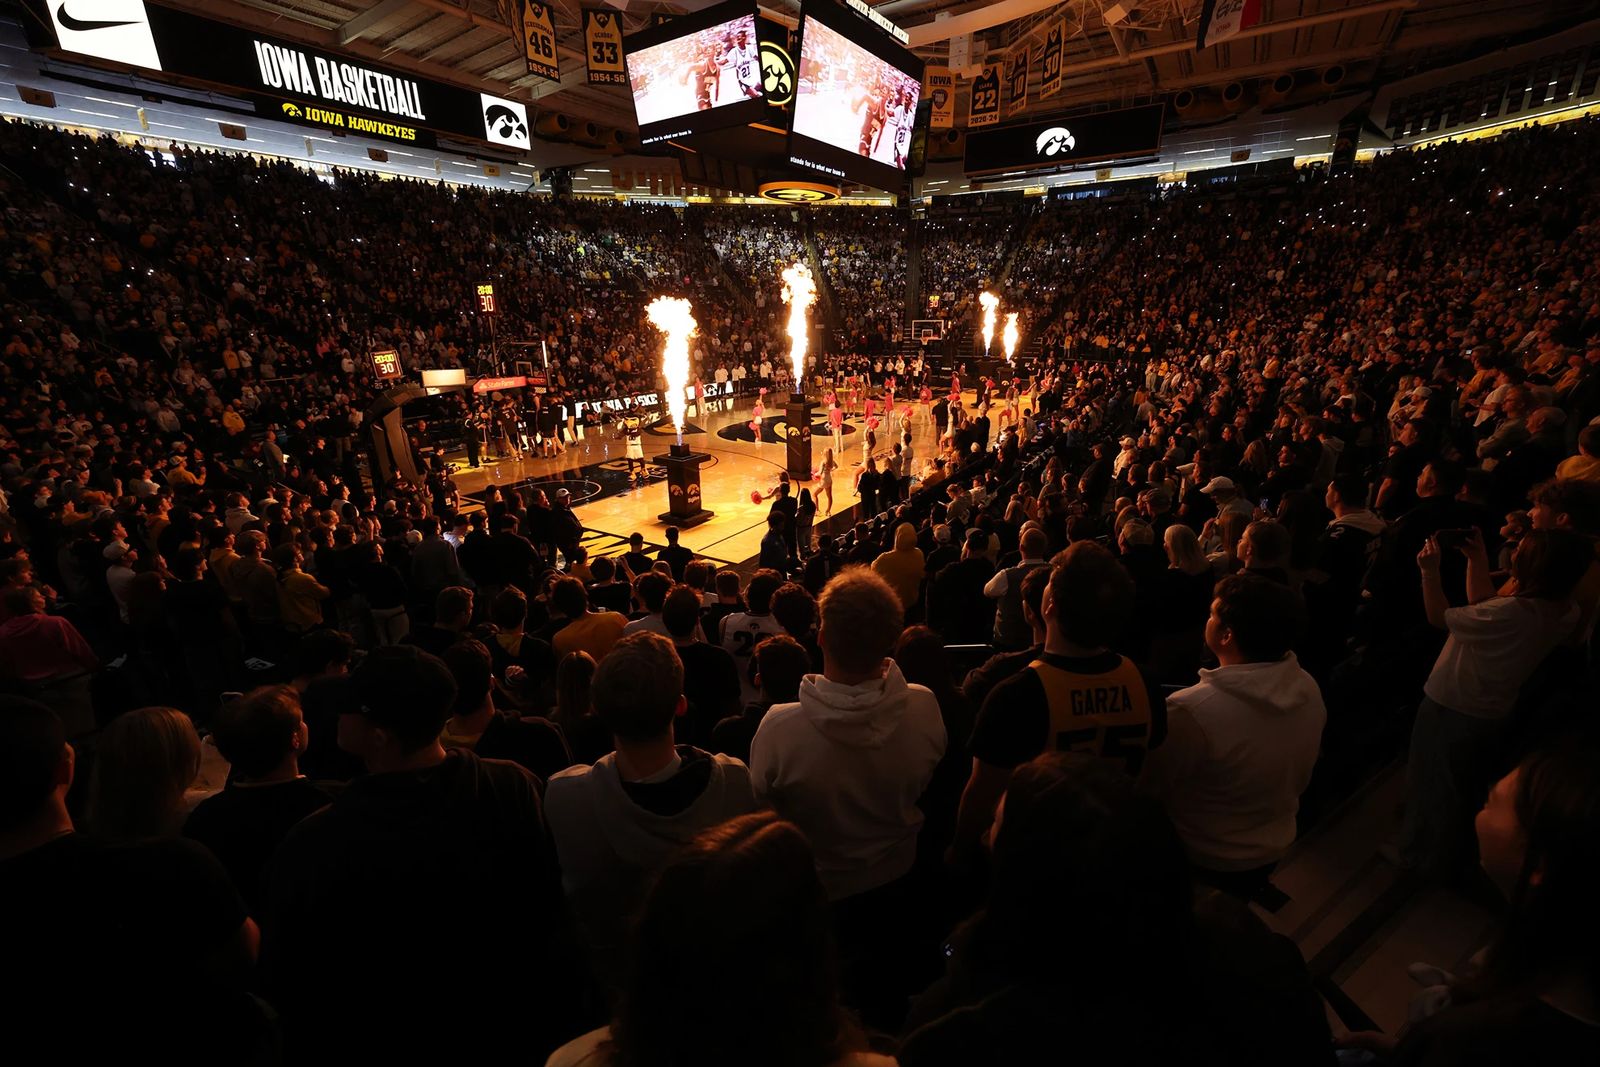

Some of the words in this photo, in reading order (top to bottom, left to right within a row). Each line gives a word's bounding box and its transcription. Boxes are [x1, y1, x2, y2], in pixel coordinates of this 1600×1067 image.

[530, 31, 553, 58] 46
[592, 42, 618, 64] 33
[254, 40, 317, 96] IOWA
[314, 56, 426, 120] BASKETBALL
[590, 73, 625, 83] 1954-56
[741, 66, 751, 78] 21
[930, 75, 952, 85] IOWA
[975, 89, 997, 110] 22
[305, 107, 344, 127] IOWA
[348, 116, 416, 141] HAWKEYES
[480, 295, 494, 312] 30
[374, 353, 395, 364] 20:00
[380, 363, 395, 374] 30
[1071, 685, 1133, 716] GARZA
